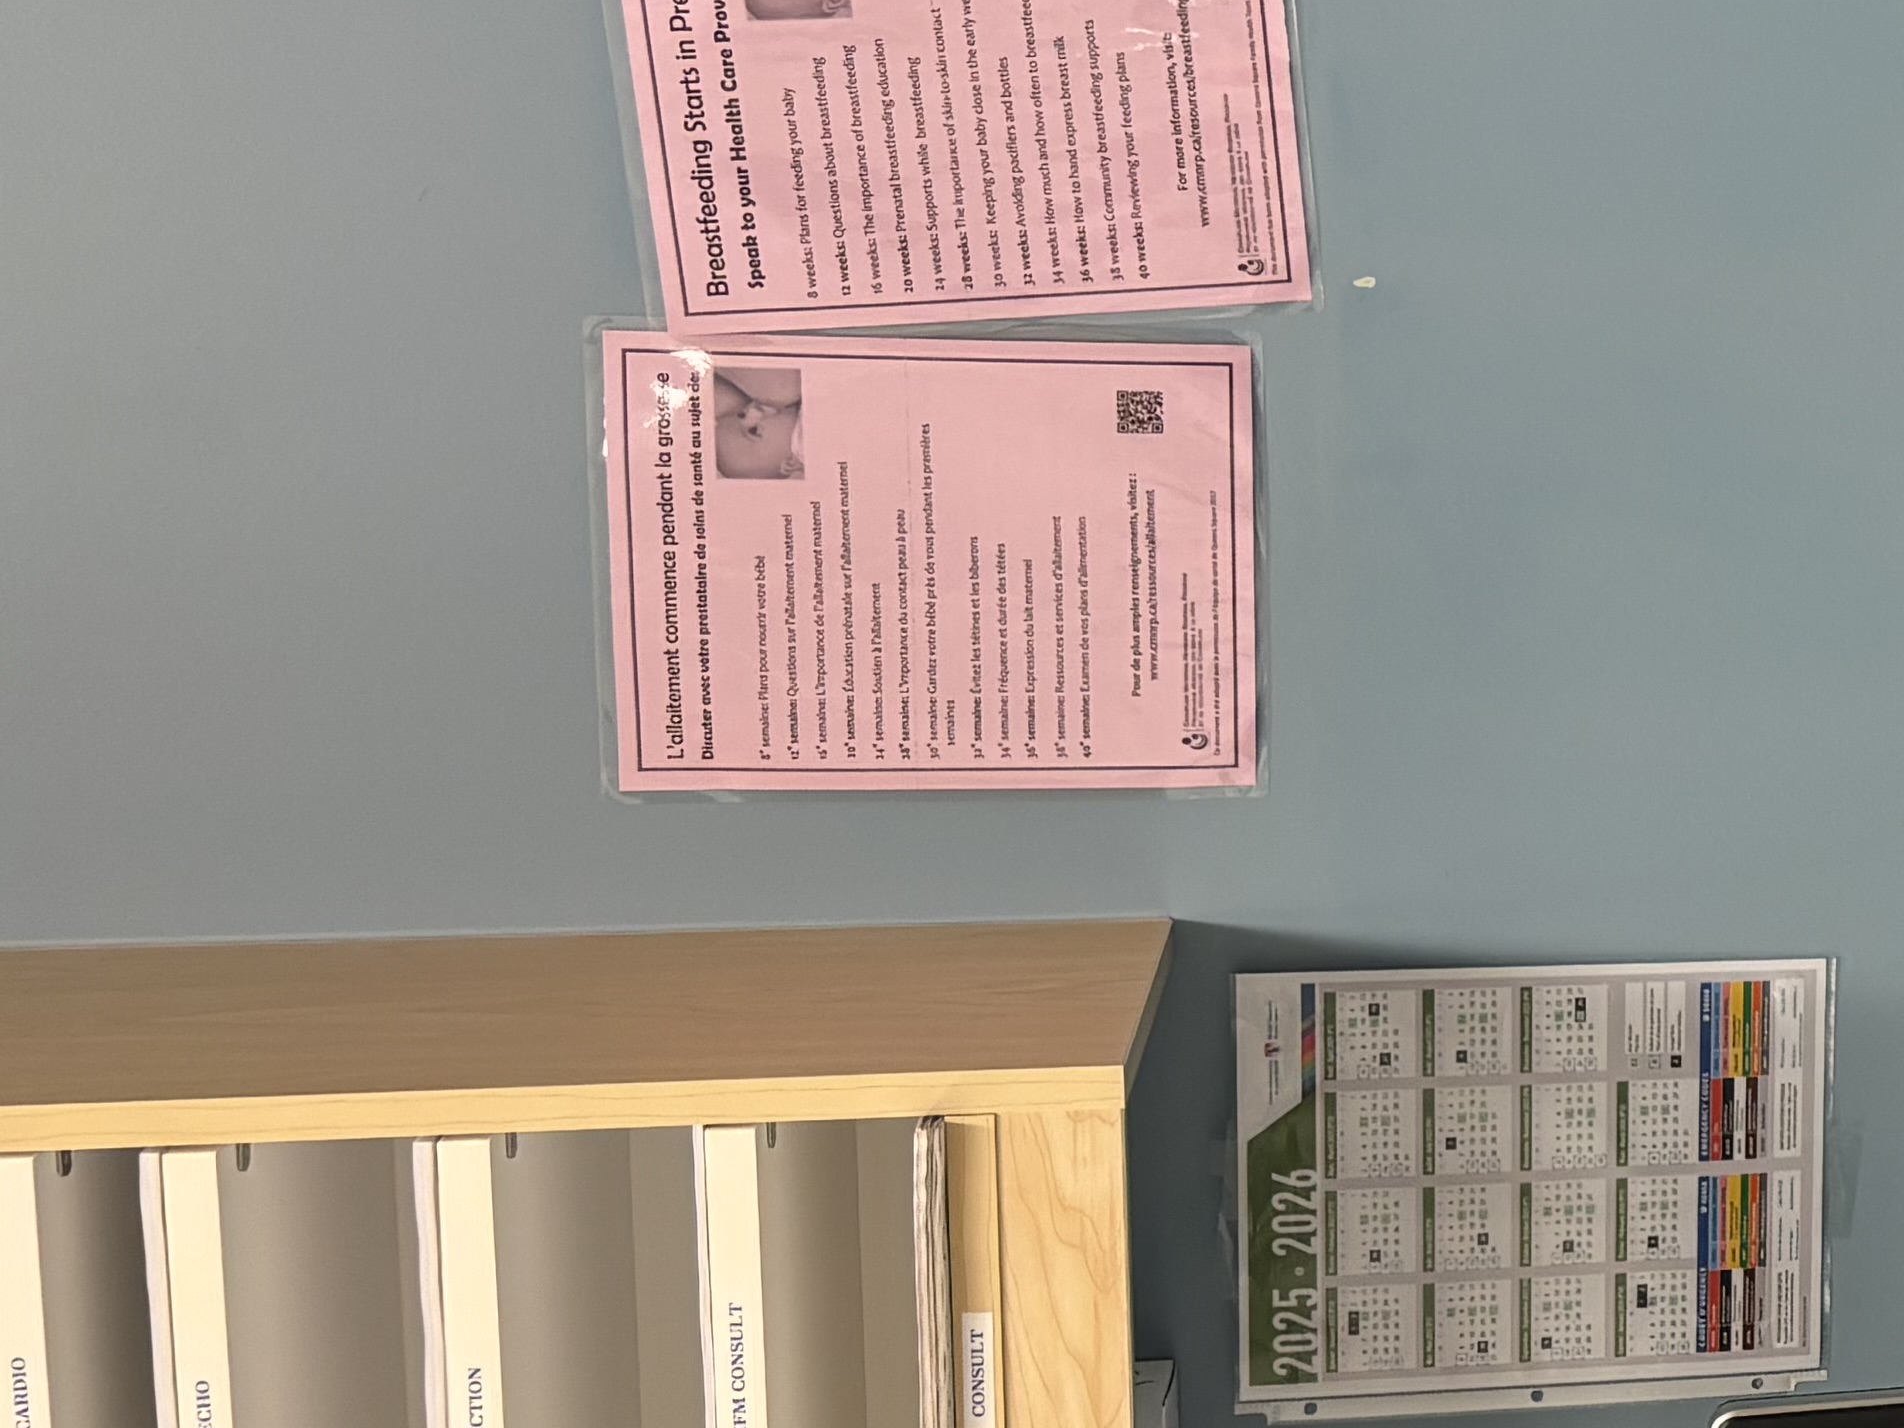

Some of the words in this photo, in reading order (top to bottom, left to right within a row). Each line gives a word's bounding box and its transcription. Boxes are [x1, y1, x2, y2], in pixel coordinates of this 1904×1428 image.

[674, 39, 697, 61] in
[1052, 35, 1067, 61] milk
[719, 48, 738, 93] Care
[1057, 62, 1072, 101] breast
[678, 67, 707, 133] Starts
[722, 97, 747, 162] Health
[1062, 101, 1078, 147] express
[1064, 148, 1080, 180] hand
[735, 166, 756, 209] your
[1070, 181, 1082, 195] to
[689, 139, 730, 297] Breastfeeding
[739, 212, 756, 232] to
[1072, 196, 1085, 224] How
[740, 235, 765, 290] Speak
[1074, 225, 1090, 268] weeks:
[1078, 269, 1094, 284] 36
[686, 395, 702, 428] sujet
[653, 451, 672, 469] la
[690, 430, 702, 449] au
[688, 451, 703, 487] santé
[655, 473, 680, 547] pendant
[690, 489, 704, 507] de
[692, 509, 707, 541] soins
[692, 543, 707, 561] de
[662, 550, 679, 645] commence
[693, 562, 711, 636] prestataire
[696, 638, 710, 674] votre
[662, 648, 685, 761] L'allaitement
[700, 675, 712, 707] avec
[700, 708, 714, 761] Discuter
[1271, 1167, 1319, 1257] 2026
[728, 1302, 745, 1393] CONSULT
[1271, 1287, 1319, 1377] 2025
[969, 1328, 986, 1419] CONSULT
